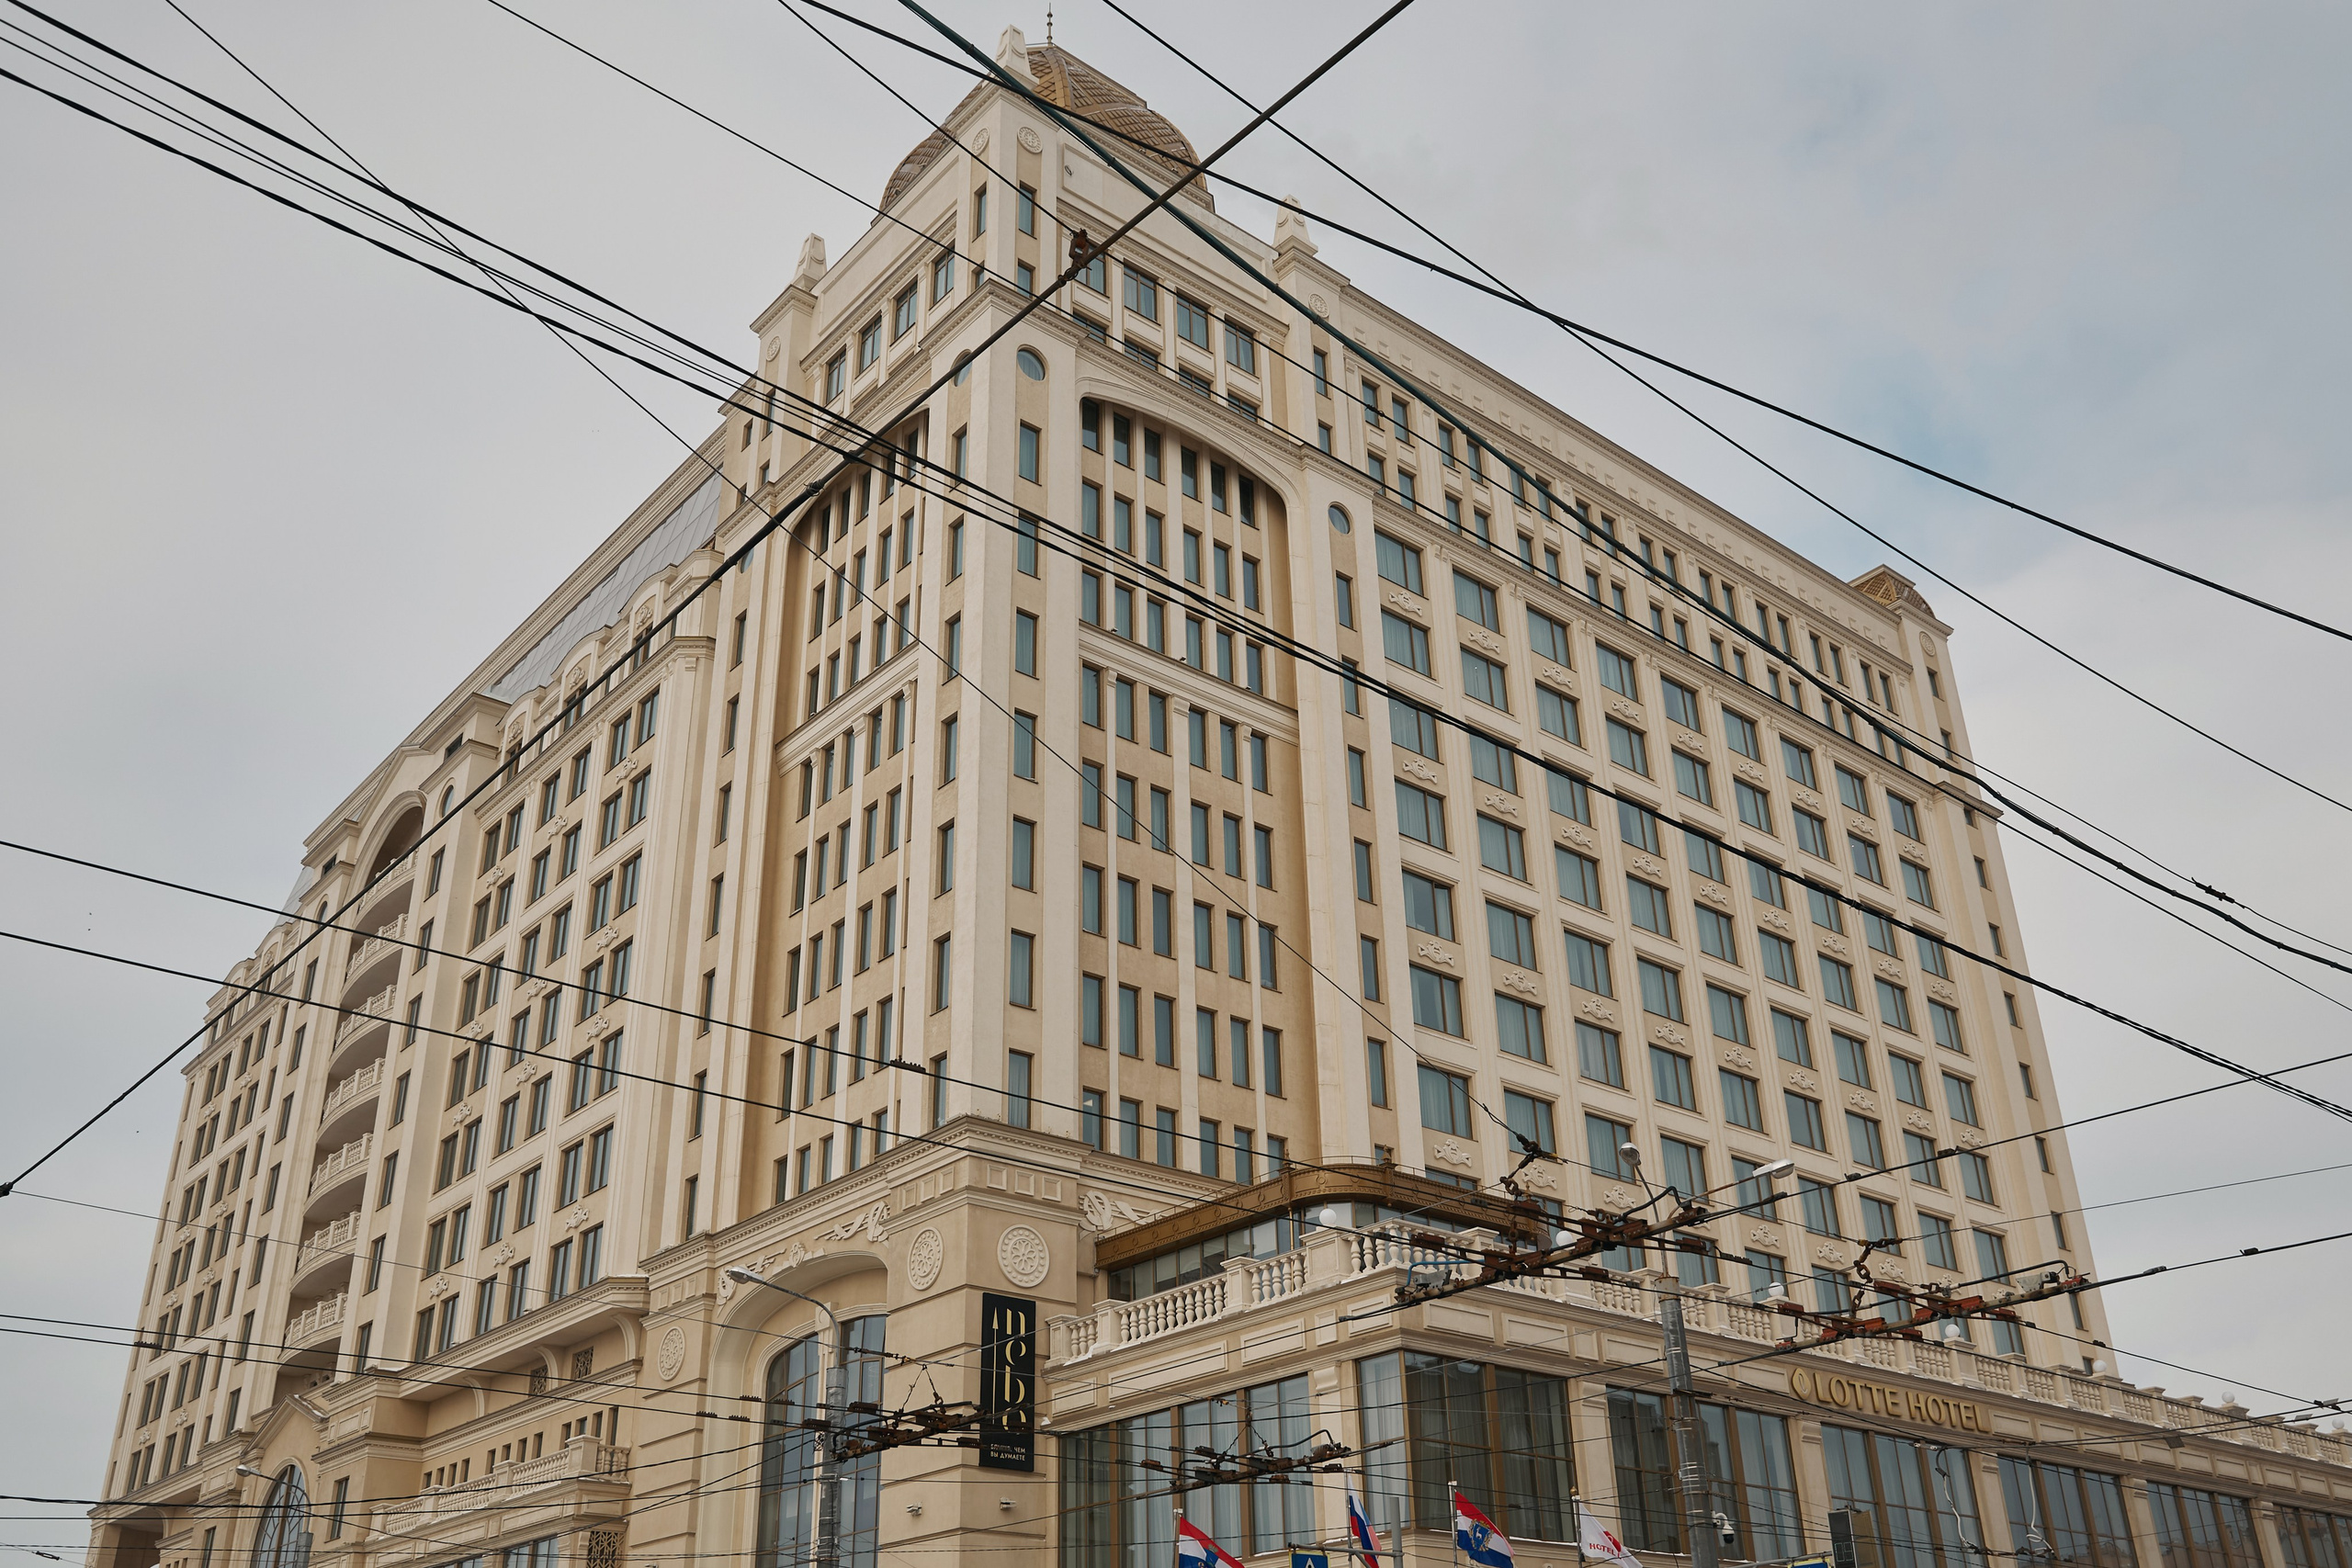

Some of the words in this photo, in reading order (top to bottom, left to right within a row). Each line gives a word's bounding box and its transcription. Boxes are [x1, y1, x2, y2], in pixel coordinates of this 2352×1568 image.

[1813, 1371, 1902, 1416] LOTTE
[1905, 1392, 1992, 1433] HOTEL
[1000, 1452, 1025, 1461] ДУМАЕТЕ
[1589, 1543, 1616, 1556] HOTEL
